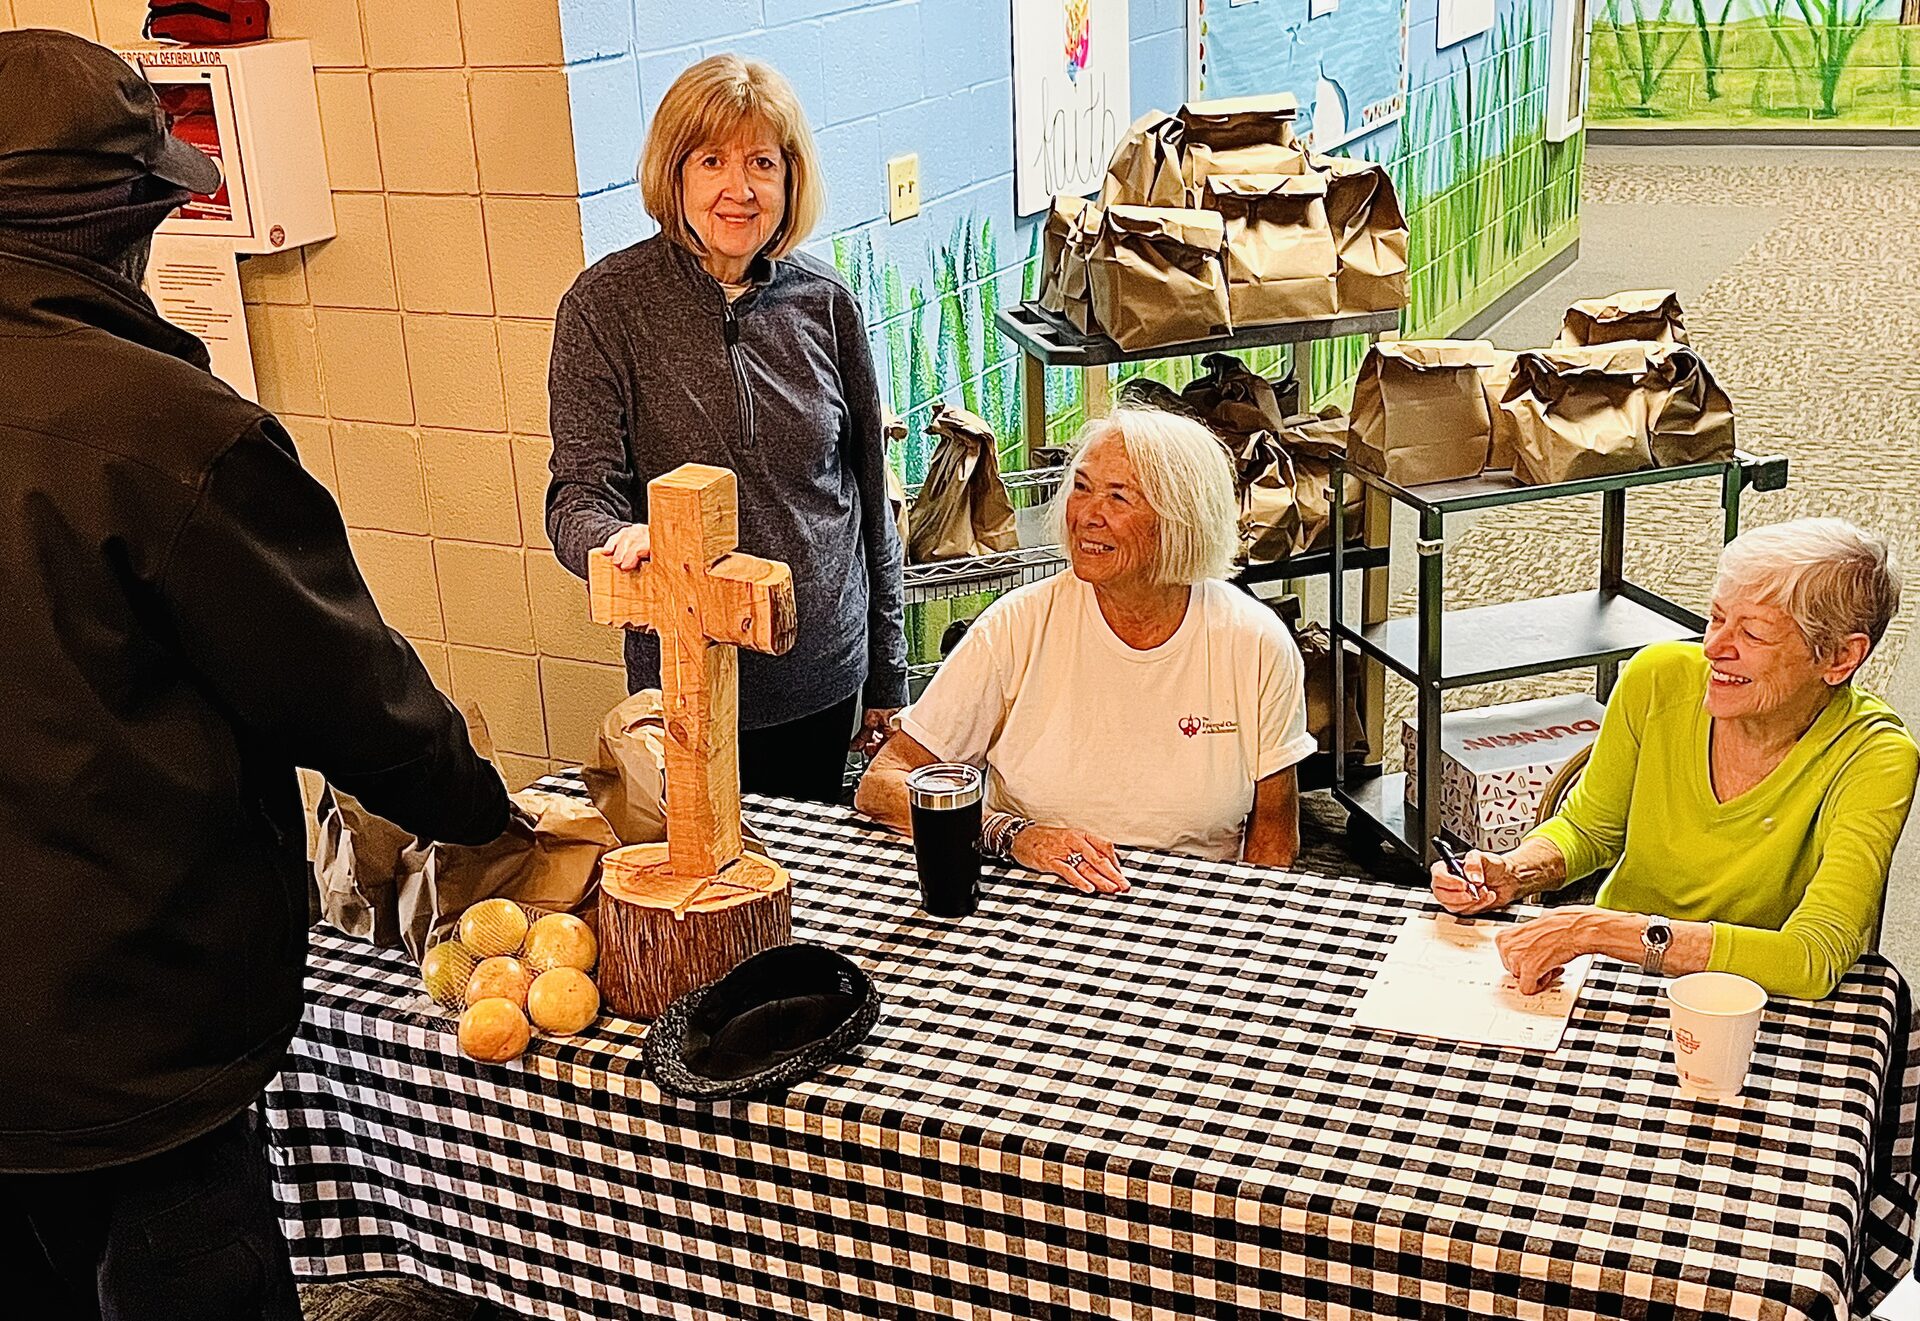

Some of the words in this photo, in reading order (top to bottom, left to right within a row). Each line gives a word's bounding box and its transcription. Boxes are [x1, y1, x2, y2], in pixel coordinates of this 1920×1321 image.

[119, 52, 158, 65] ERGENCY
[160, 52, 222, 64] DEFIBRILLATOR
[1033, 72, 1115, 196] faith
